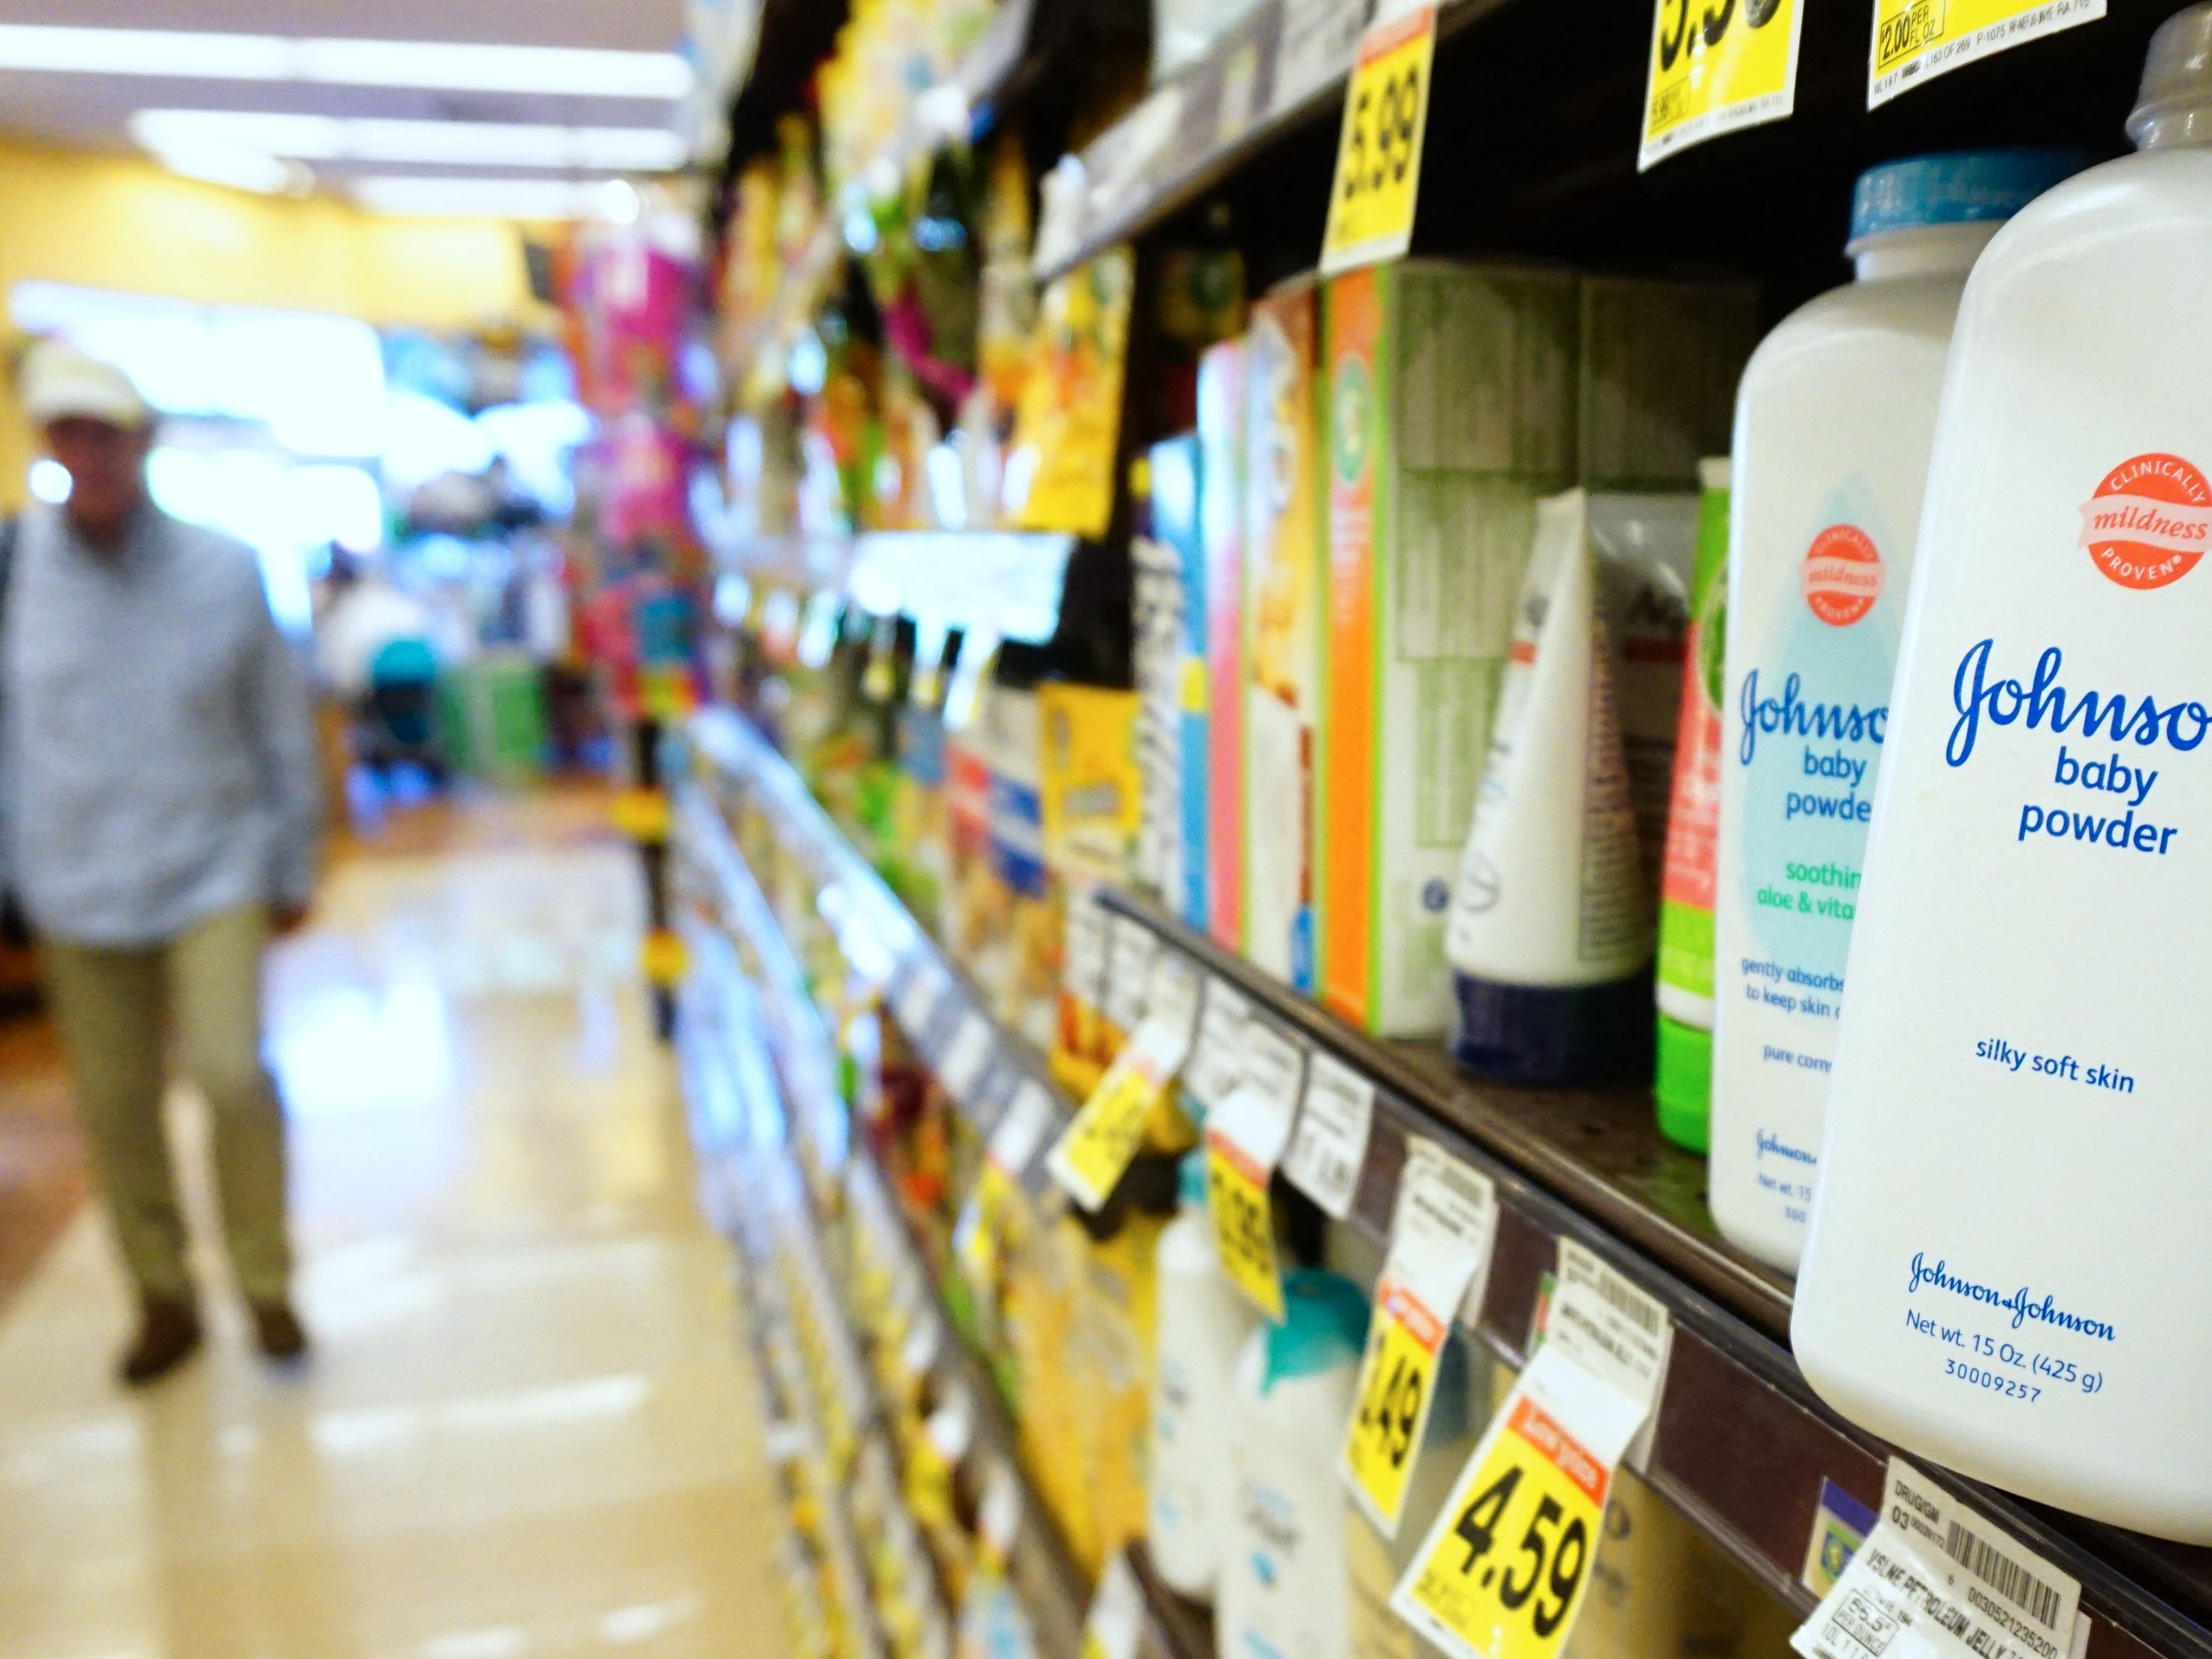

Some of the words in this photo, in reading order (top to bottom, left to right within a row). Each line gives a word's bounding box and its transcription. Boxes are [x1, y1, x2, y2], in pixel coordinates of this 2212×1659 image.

[1910, 29, 1920, 46] FL
[1922, 19, 1935, 40] OZ
[1911, 4, 1929, 27] PER
[2109, 460, 2206, 502] CLINICALLY
[2094, 505, 2208, 540] mildness
[1808, 564, 1877, 587] mildness
[1803, 744, 1868, 788] baby
[2055, 745, 2158, 807] baby
[2018, 803, 2178, 855] powder
[1757, 883, 1793, 911] aloe
[1797, 891, 1812, 914] &
[1741, 958, 1784, 984] gently
[1746, 983, 1760, 1001] to
[1763, 985, 1797, 1013] keep
[1800, 995, 1830, 1018] skin
[1763, 1044, 1794, 1065] pure
[1976, 1038, 2027, 1072] silky
[2032, 1054, 2079, 1082] soft
[2085, 1064, 2135, 1094] skin
[1906, 1309, 1937, 1338] Net
[1940, 1326, 1966, 1348] wt.
[1971, 1333, 1994, 1357] 15
[1999, 1343, 2026, 1370] Oz.
[2032, 1353, 2078, 1384] (425
[2082, 1370, 2103, 1394] g)
[1944, 1358, 2042, 1404] 30009257
[1892, 1506, 1909, 1530] 03
[1452, 1463, 1588, 1638] 4.59
[1837, 1610, 1856, 1627] PER
[1853, 1624, 1885, 1655] OUNCE
